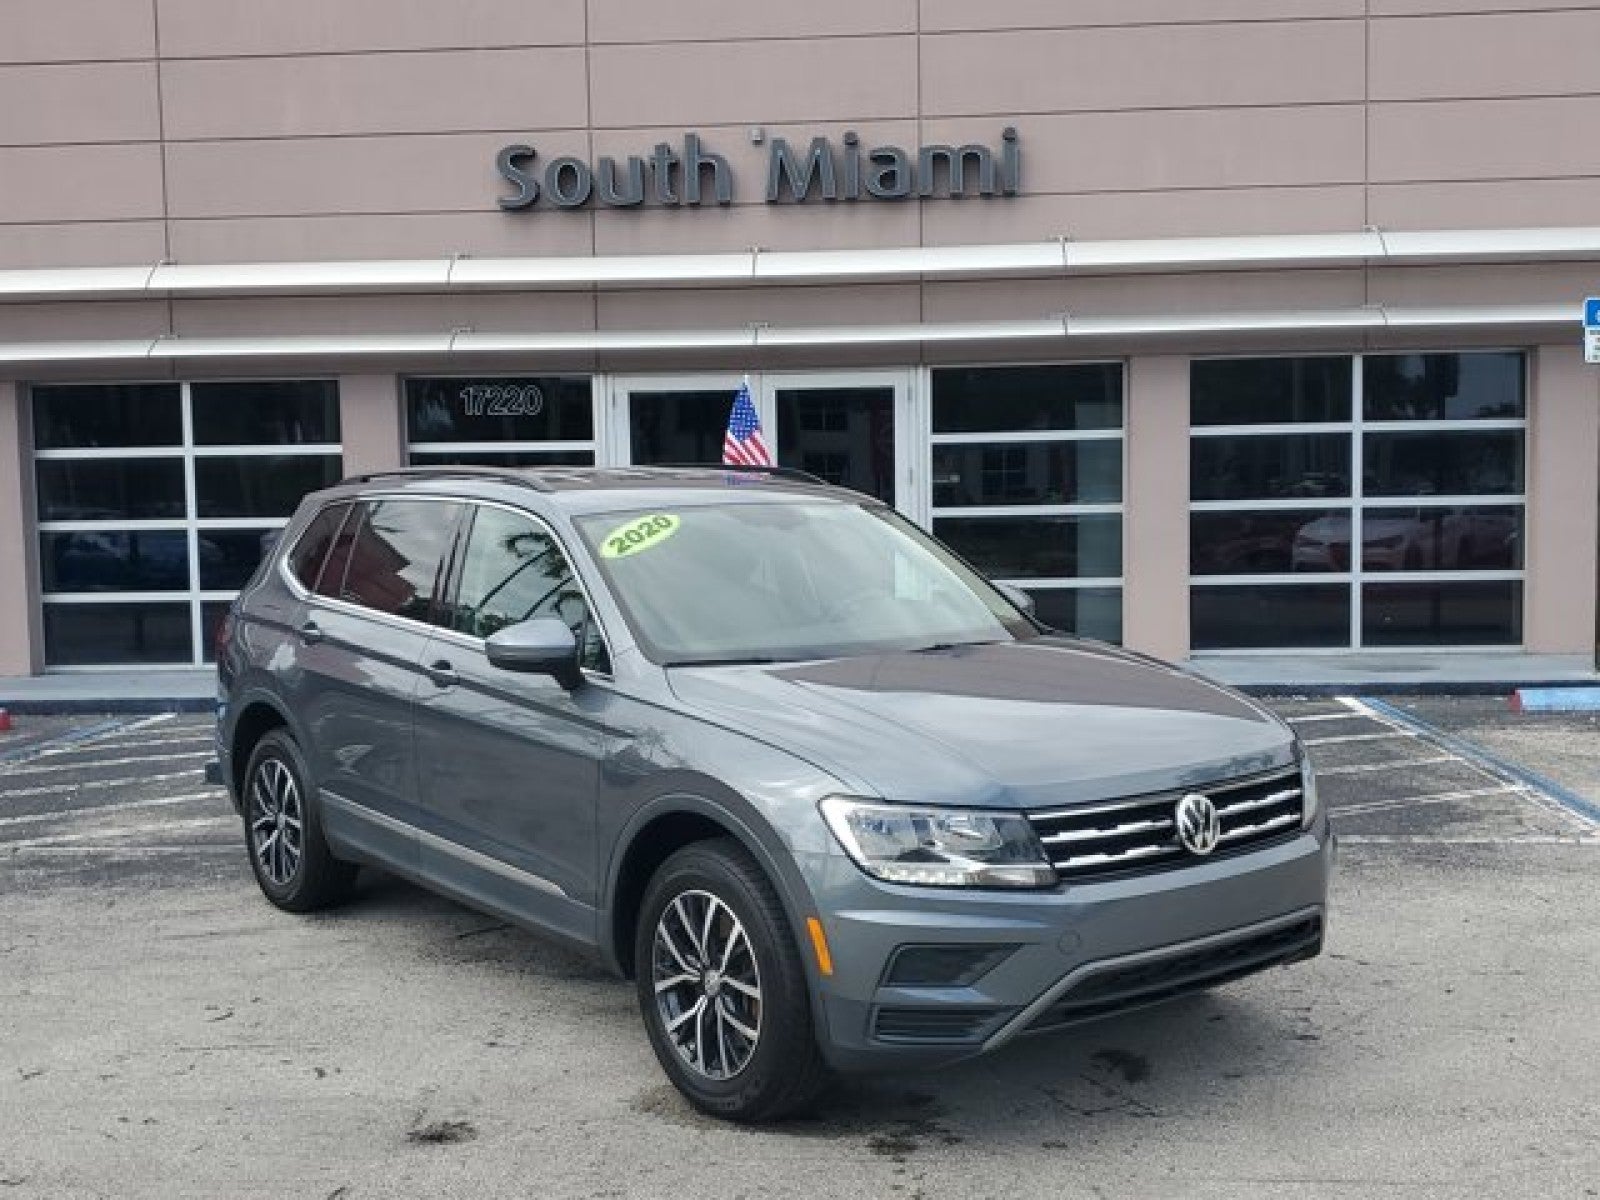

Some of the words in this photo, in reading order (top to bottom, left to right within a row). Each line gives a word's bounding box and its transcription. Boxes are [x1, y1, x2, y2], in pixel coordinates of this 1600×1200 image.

[497, 132, 734, 211] South
[766, 127, 1021, 205] Miami
[460, 384, 543, 416] 17220
[608, 516, 673, 554] 2020
